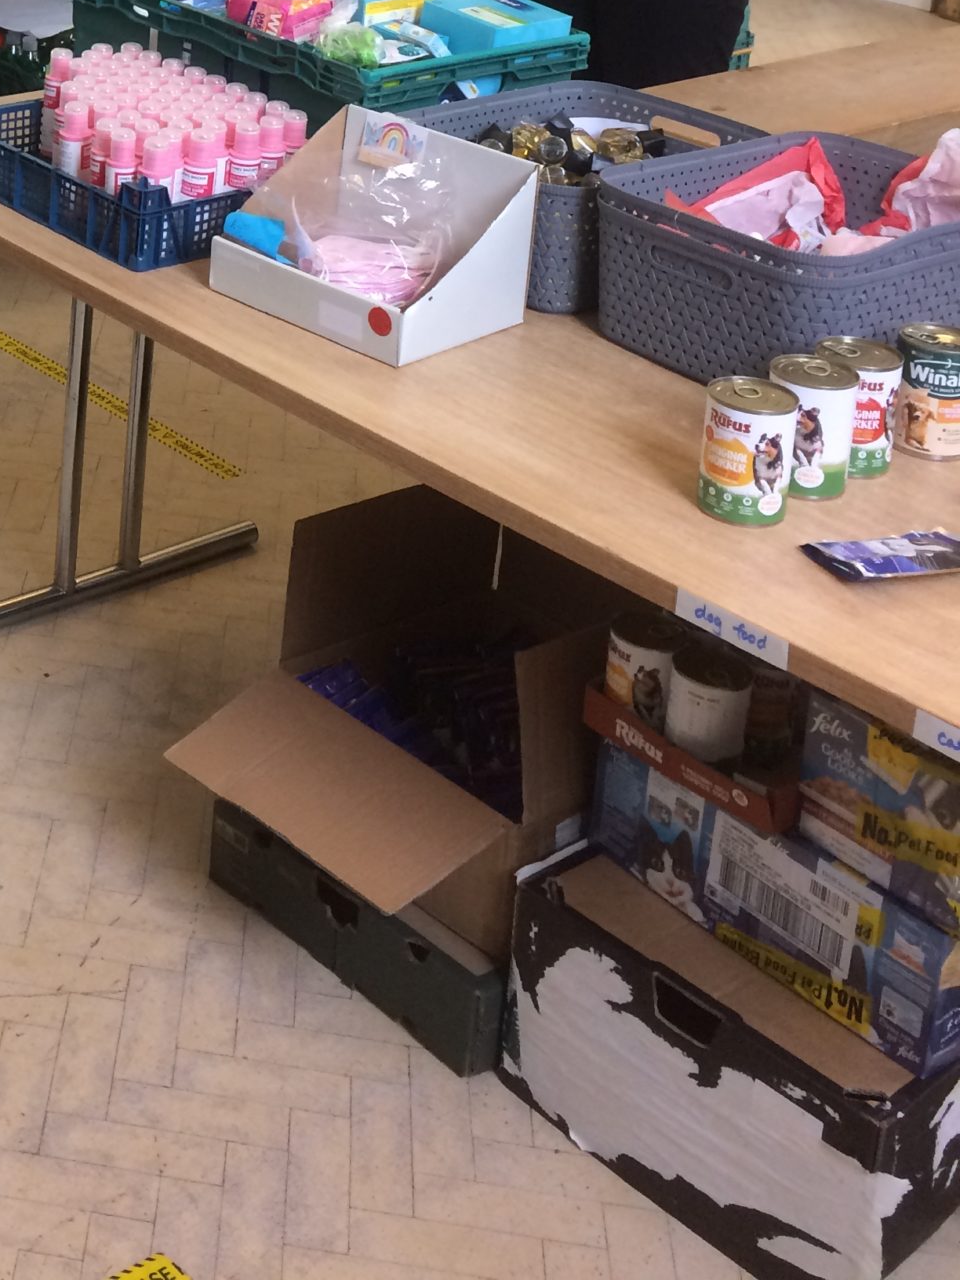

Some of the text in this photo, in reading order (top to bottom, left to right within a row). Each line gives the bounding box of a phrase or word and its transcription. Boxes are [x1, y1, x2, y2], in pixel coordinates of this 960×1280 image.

[694, 604, 768, 650] dog food
[764, 953, 797, 985] Food
[824, 981, 865, 1024] No.1
